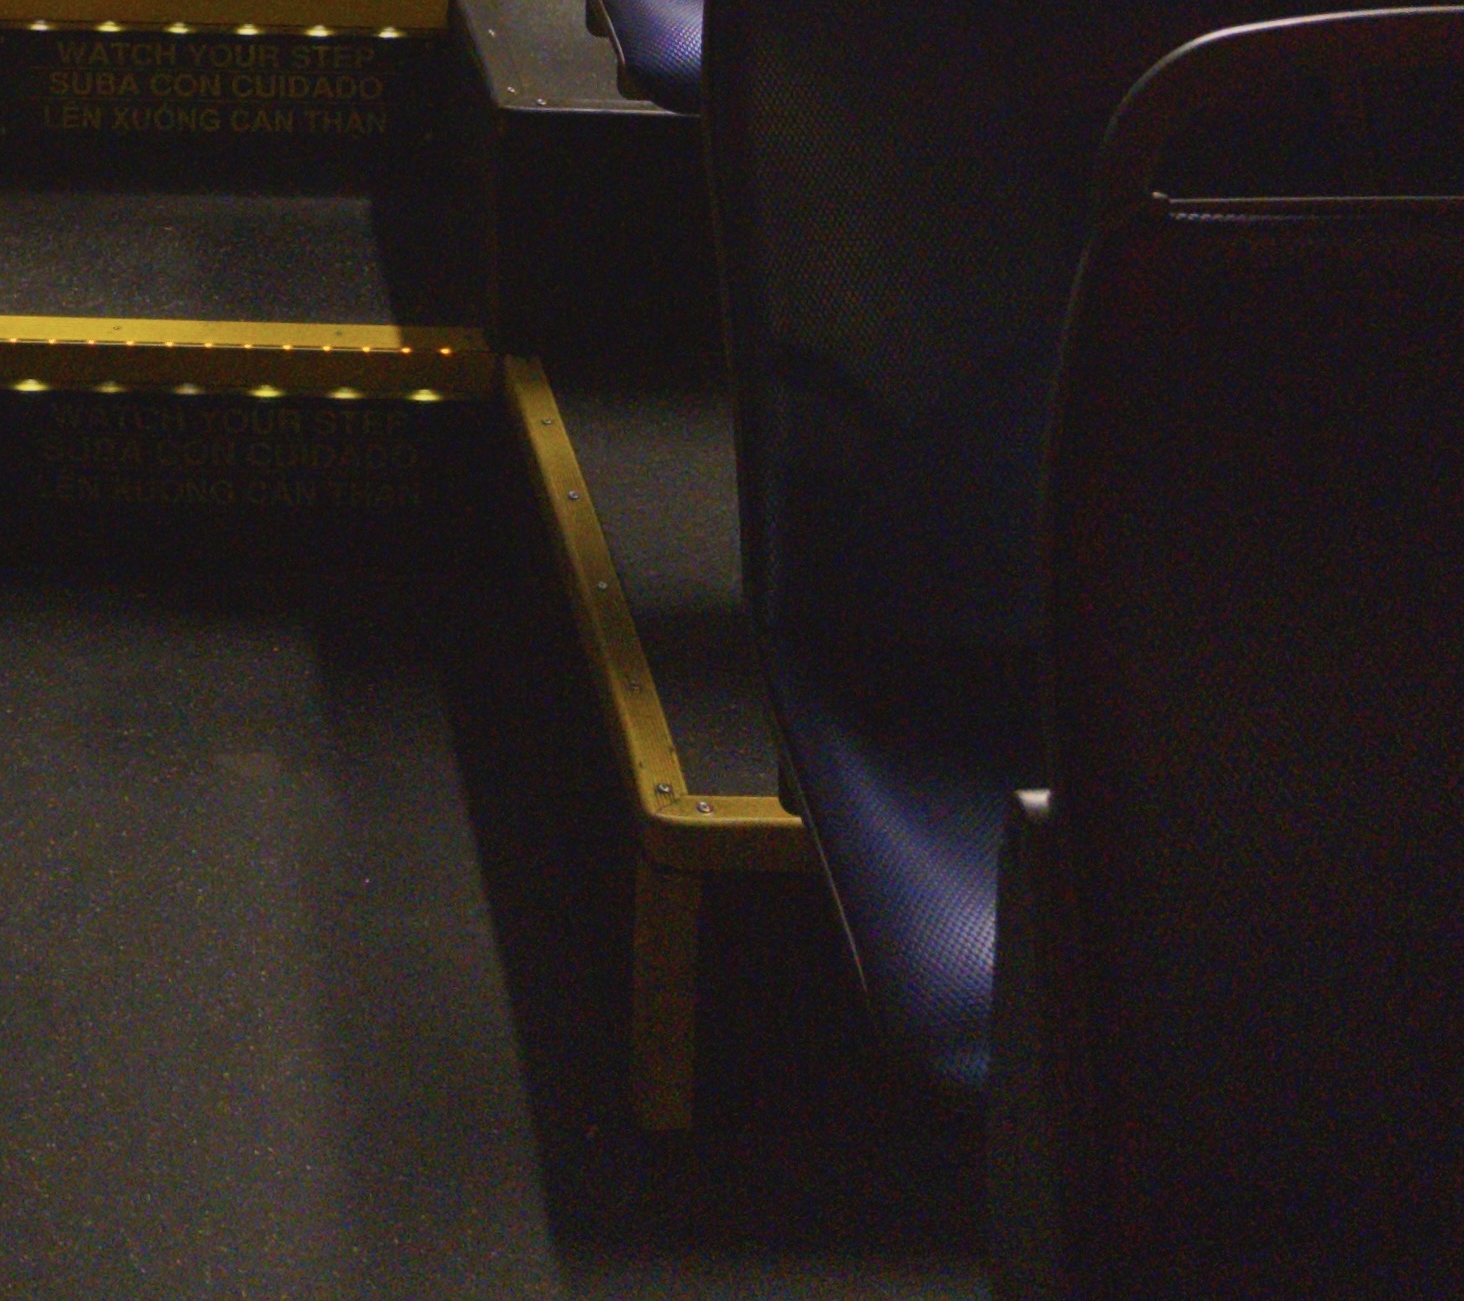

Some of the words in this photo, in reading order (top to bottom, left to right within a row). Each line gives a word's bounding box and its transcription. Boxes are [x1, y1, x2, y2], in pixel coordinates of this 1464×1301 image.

[58, 41, 176, 65] WATCH
[191, 43, 280, 67] YOUR
[291, 45, 375, 69] STEP
[49, 70, 140, 96] SUBA
[150, 73, 222, 97] CON
[231, 74, 383, 100] CUIDADO
[201, 408, 301, 435] YOUR
